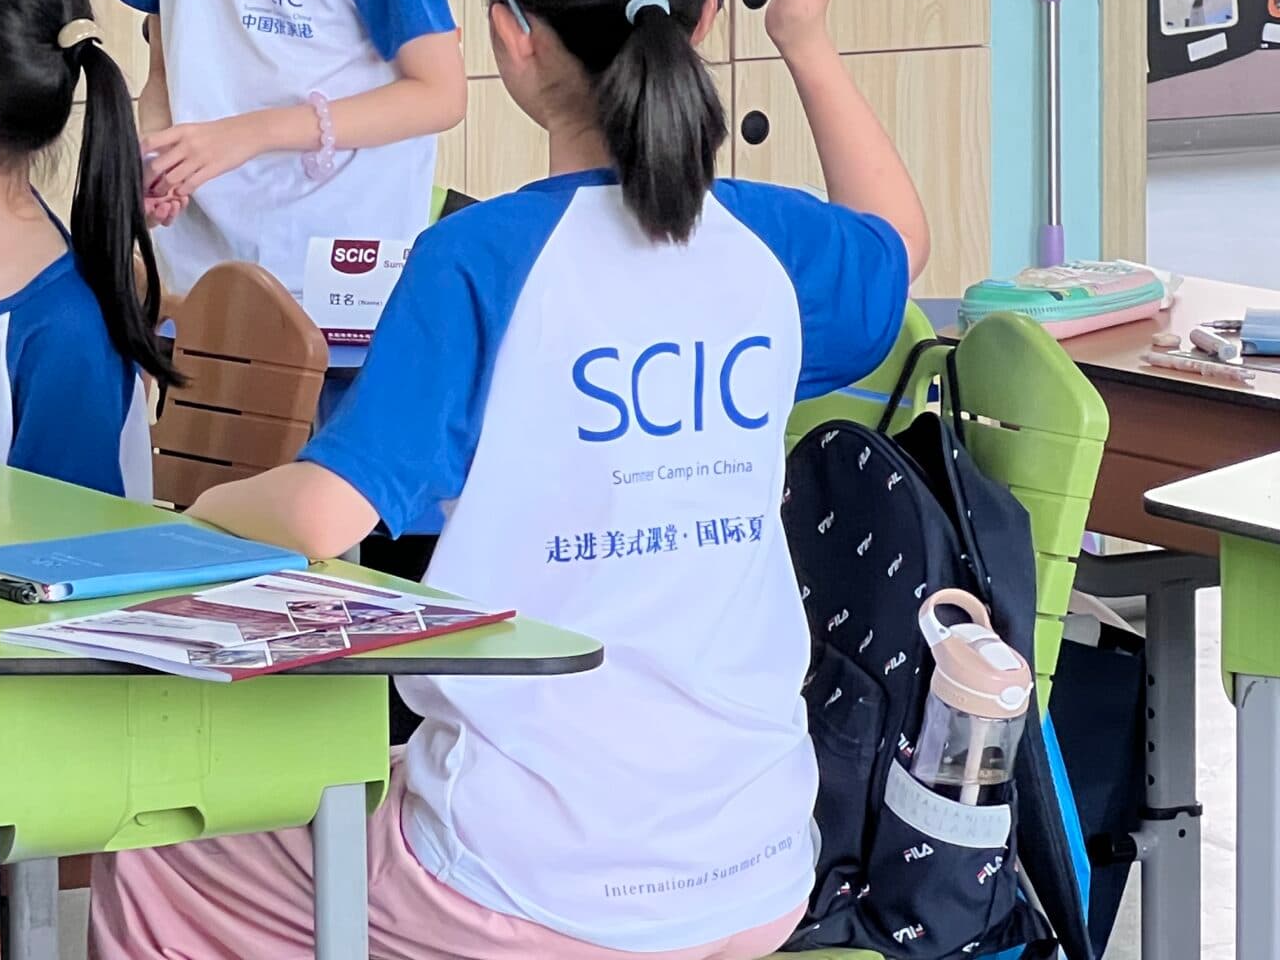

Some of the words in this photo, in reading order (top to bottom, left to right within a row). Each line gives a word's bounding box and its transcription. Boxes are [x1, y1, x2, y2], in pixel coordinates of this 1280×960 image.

[334, 247, 376, 263] SCIC
[571, 335, 771, 443] SCIC
[657, 465, 694, 480] Camp
[696, 460, 709, 476] in
[713, 459, 753, 475] China
[884, 651, 907, 676] FILA
[903, 842, 935, 864] FILA
[604, 872, 709, 898] International
[711, 852, 762, 881] Summer
[763, 835, 794, 859] Camp
[976, 855, 1004, 885] FILA
[892, 923, 927, 944] FILA
